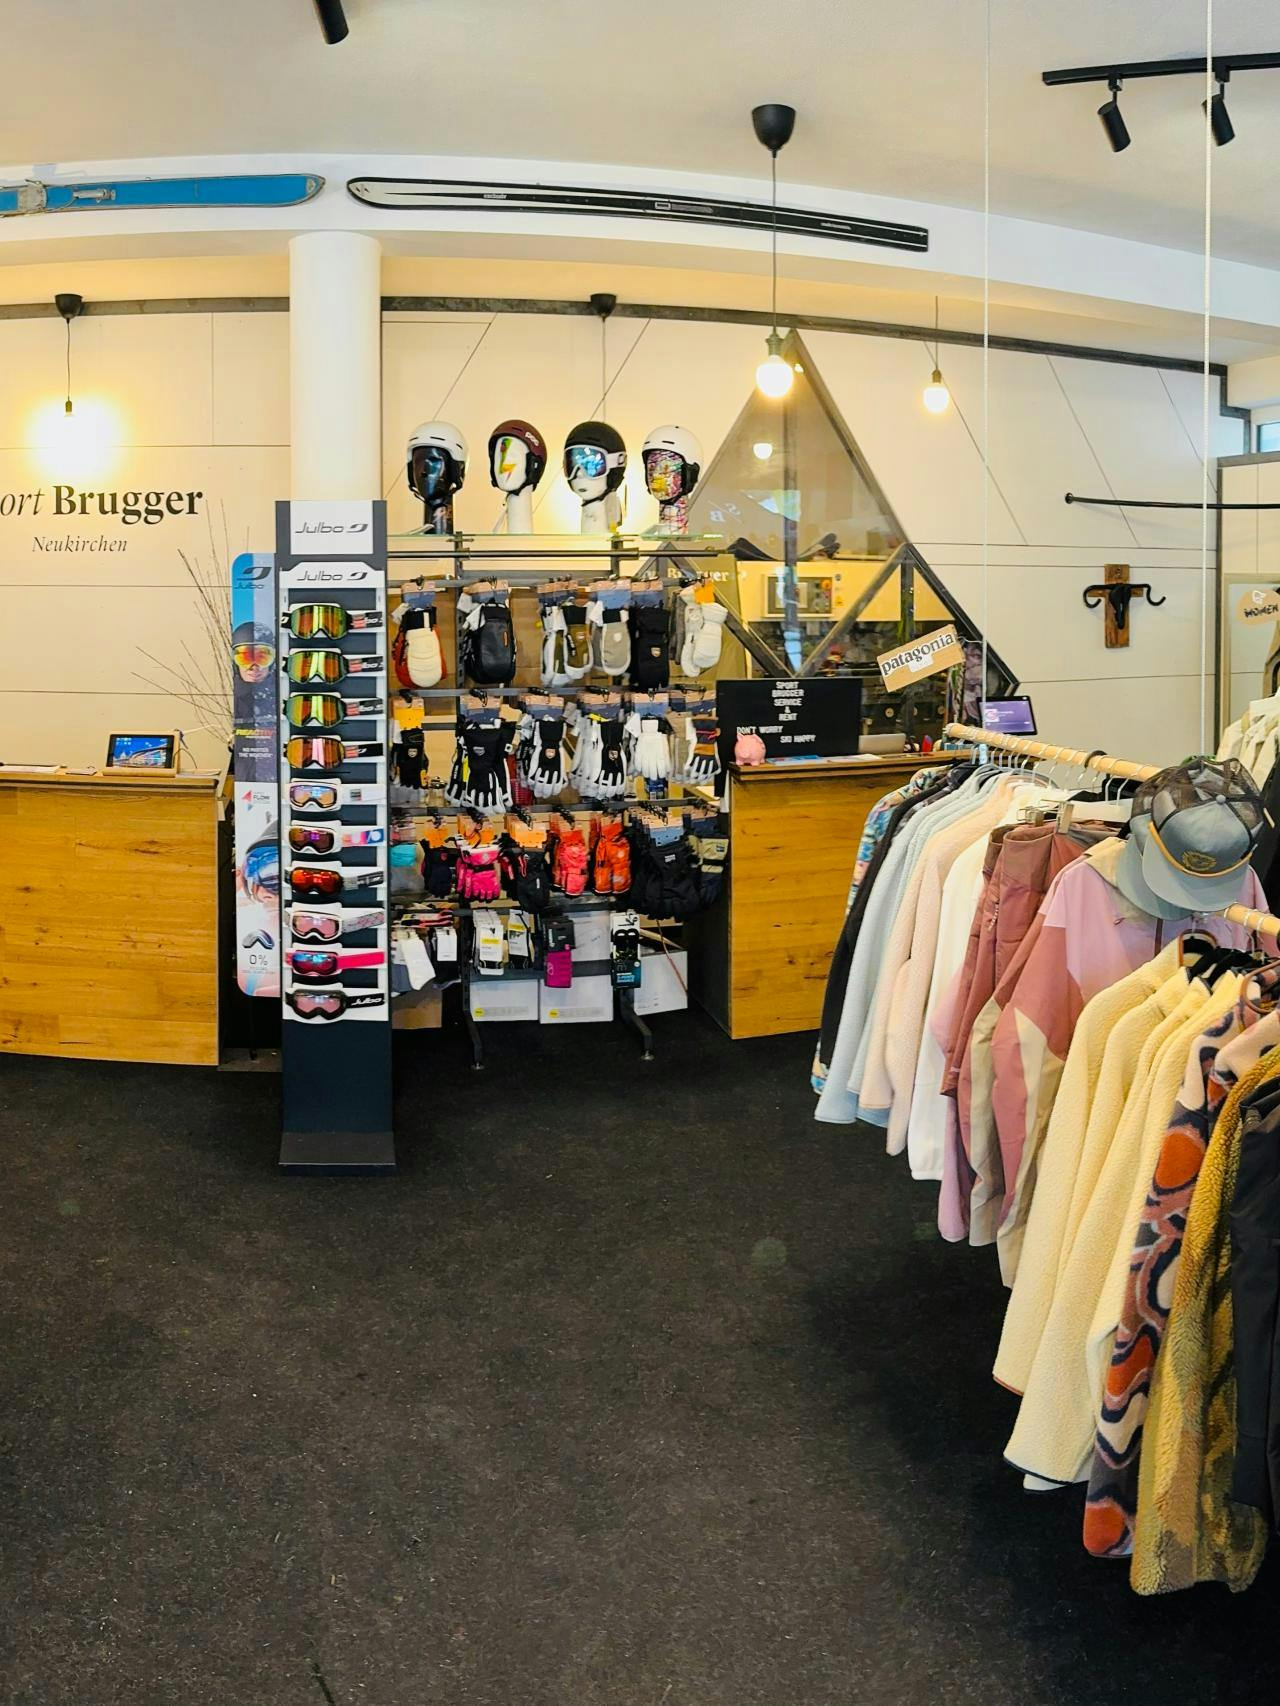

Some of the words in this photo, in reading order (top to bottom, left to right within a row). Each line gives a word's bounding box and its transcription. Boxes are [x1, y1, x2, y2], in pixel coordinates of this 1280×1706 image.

[52, 486, 203, 525] Brugger
[295, 522, 344, 534] Julbo
[32, 535, 128, 552] Neukirchen
[297, 570, 343, 581] Julbo
[881, 633, 954, 675] patagonia
